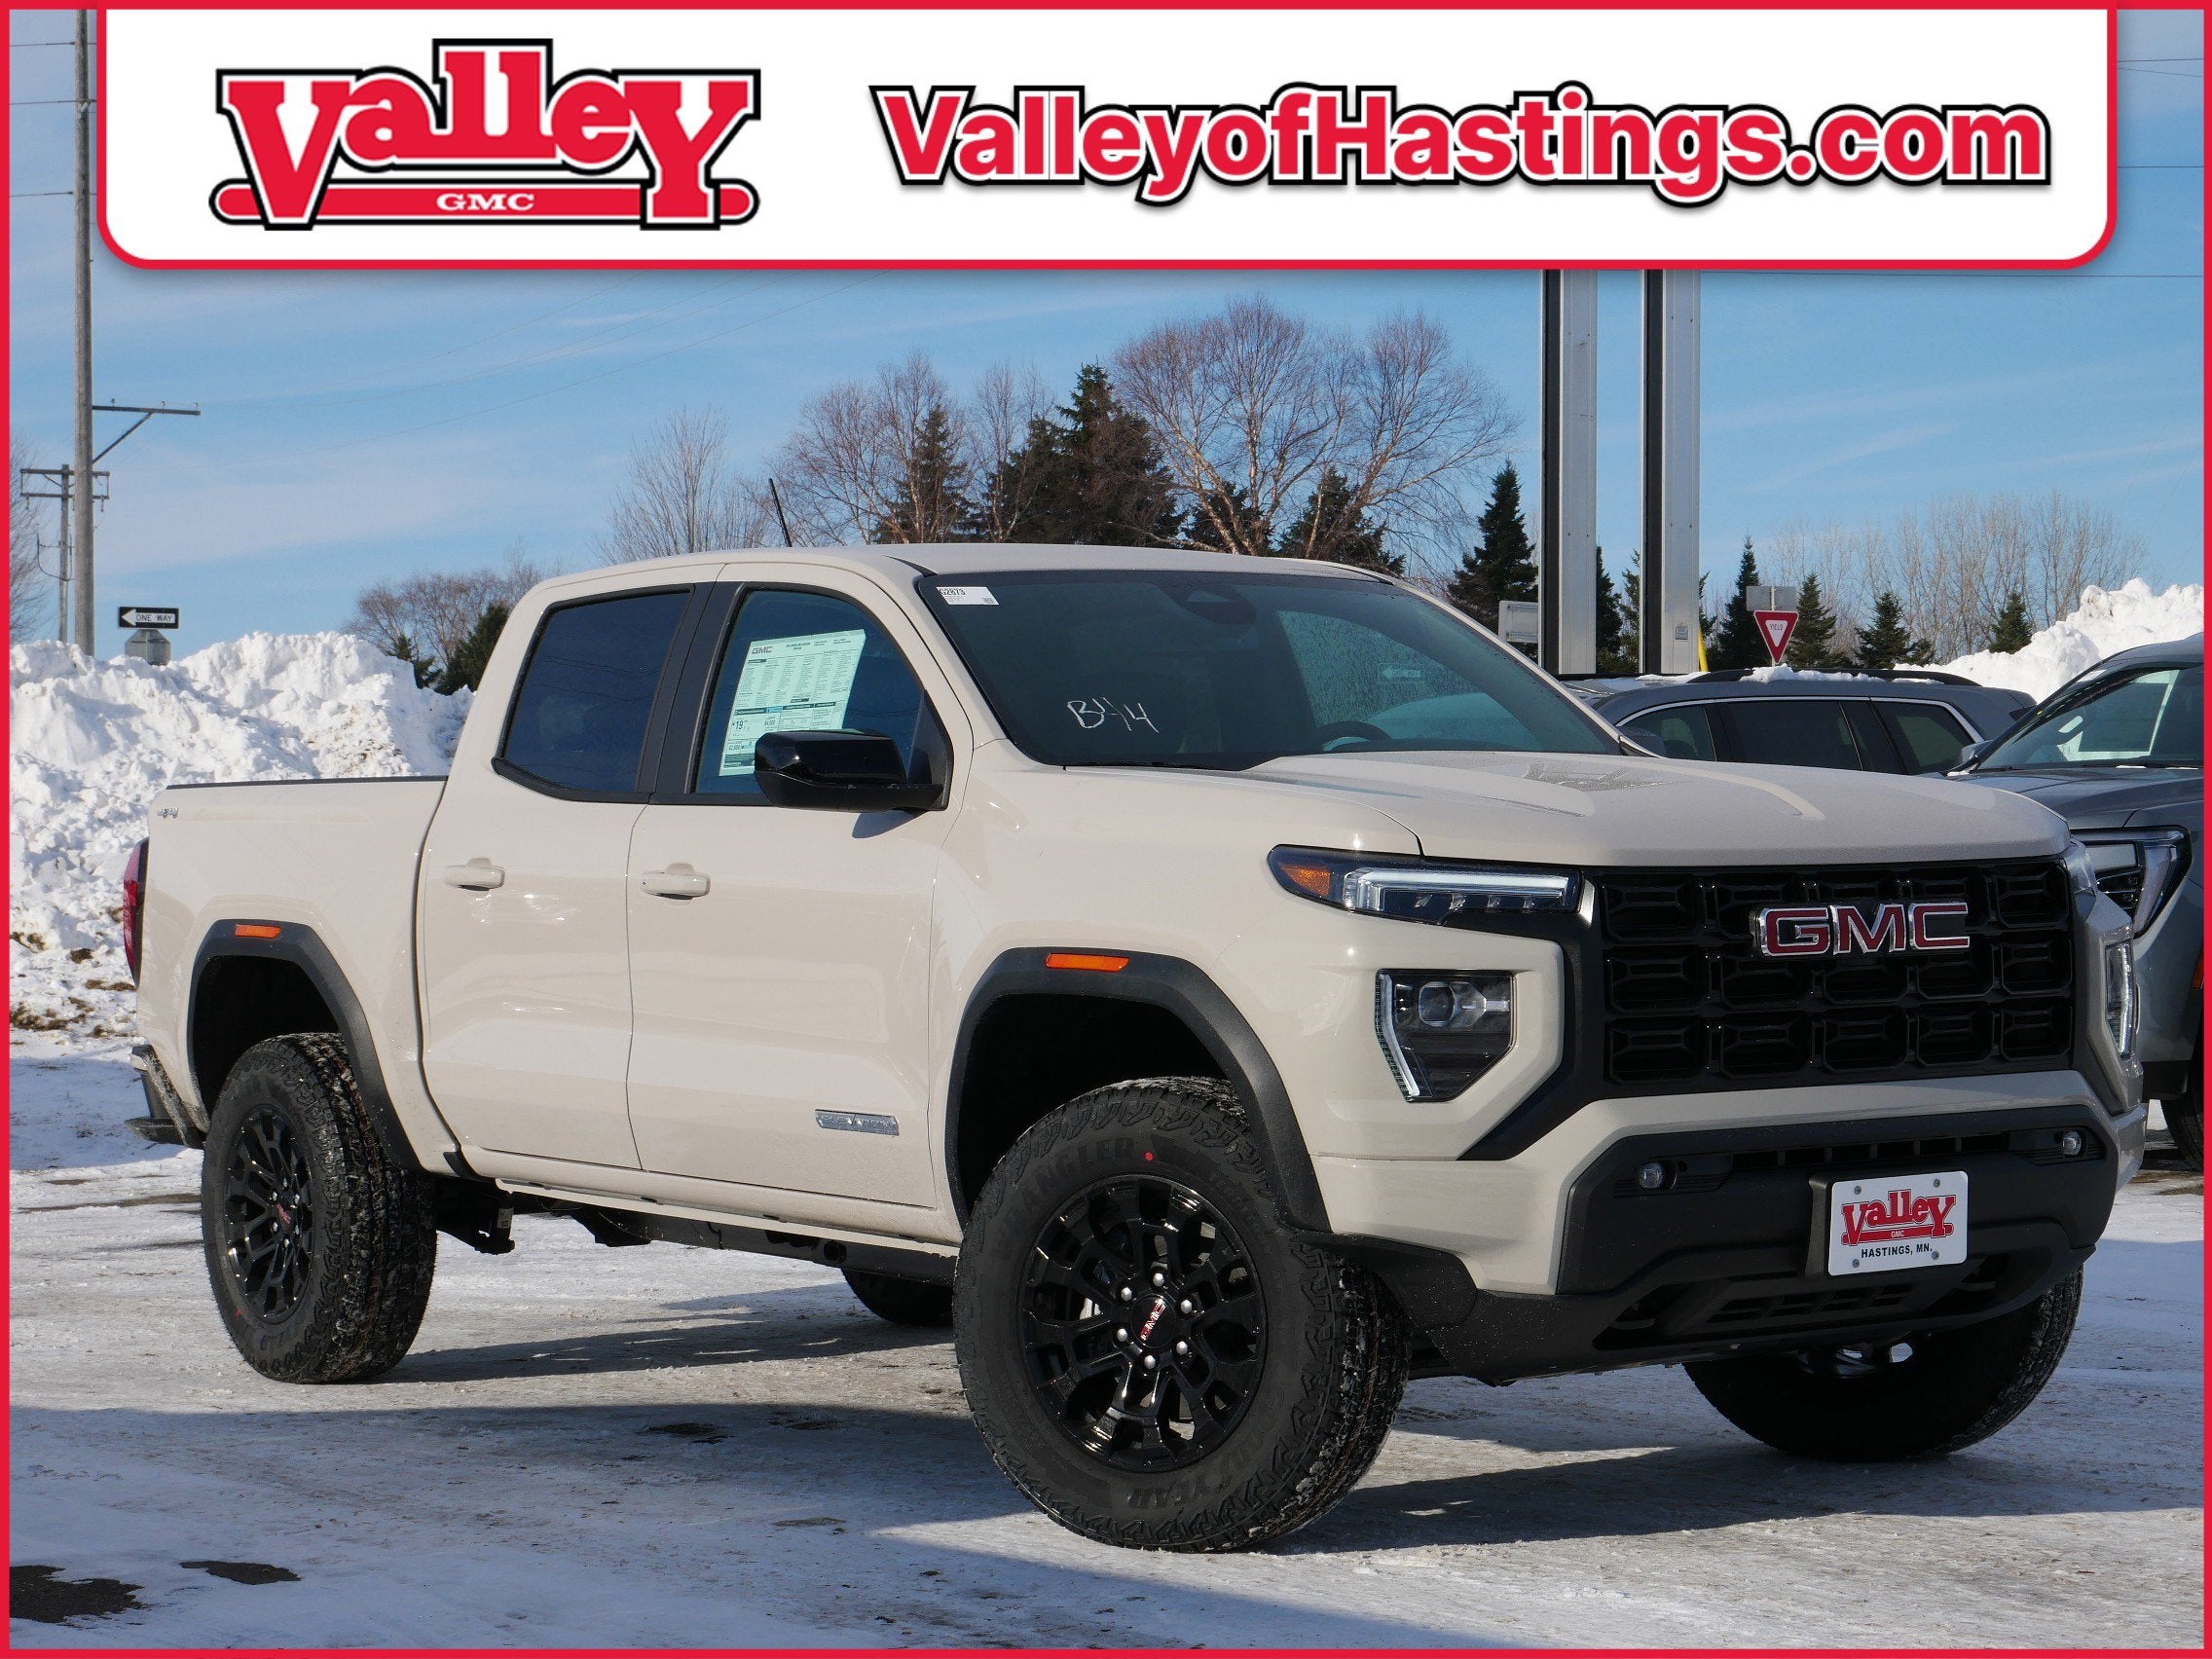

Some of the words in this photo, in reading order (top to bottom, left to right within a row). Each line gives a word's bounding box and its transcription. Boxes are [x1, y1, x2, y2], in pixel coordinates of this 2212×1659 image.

[135, 613, 153, 622] ONE
[752, 645, 773, 654] GMC
[1757, 902, 1971, 957] GMC
[1891, 1230, 1905, 1238] GMC
[1861, 1246, 1913, 1259] HASTINGS,
[1916, 1242, 1933, 1252] MN.
[1140, 1298, 1166, 1341] GMC
